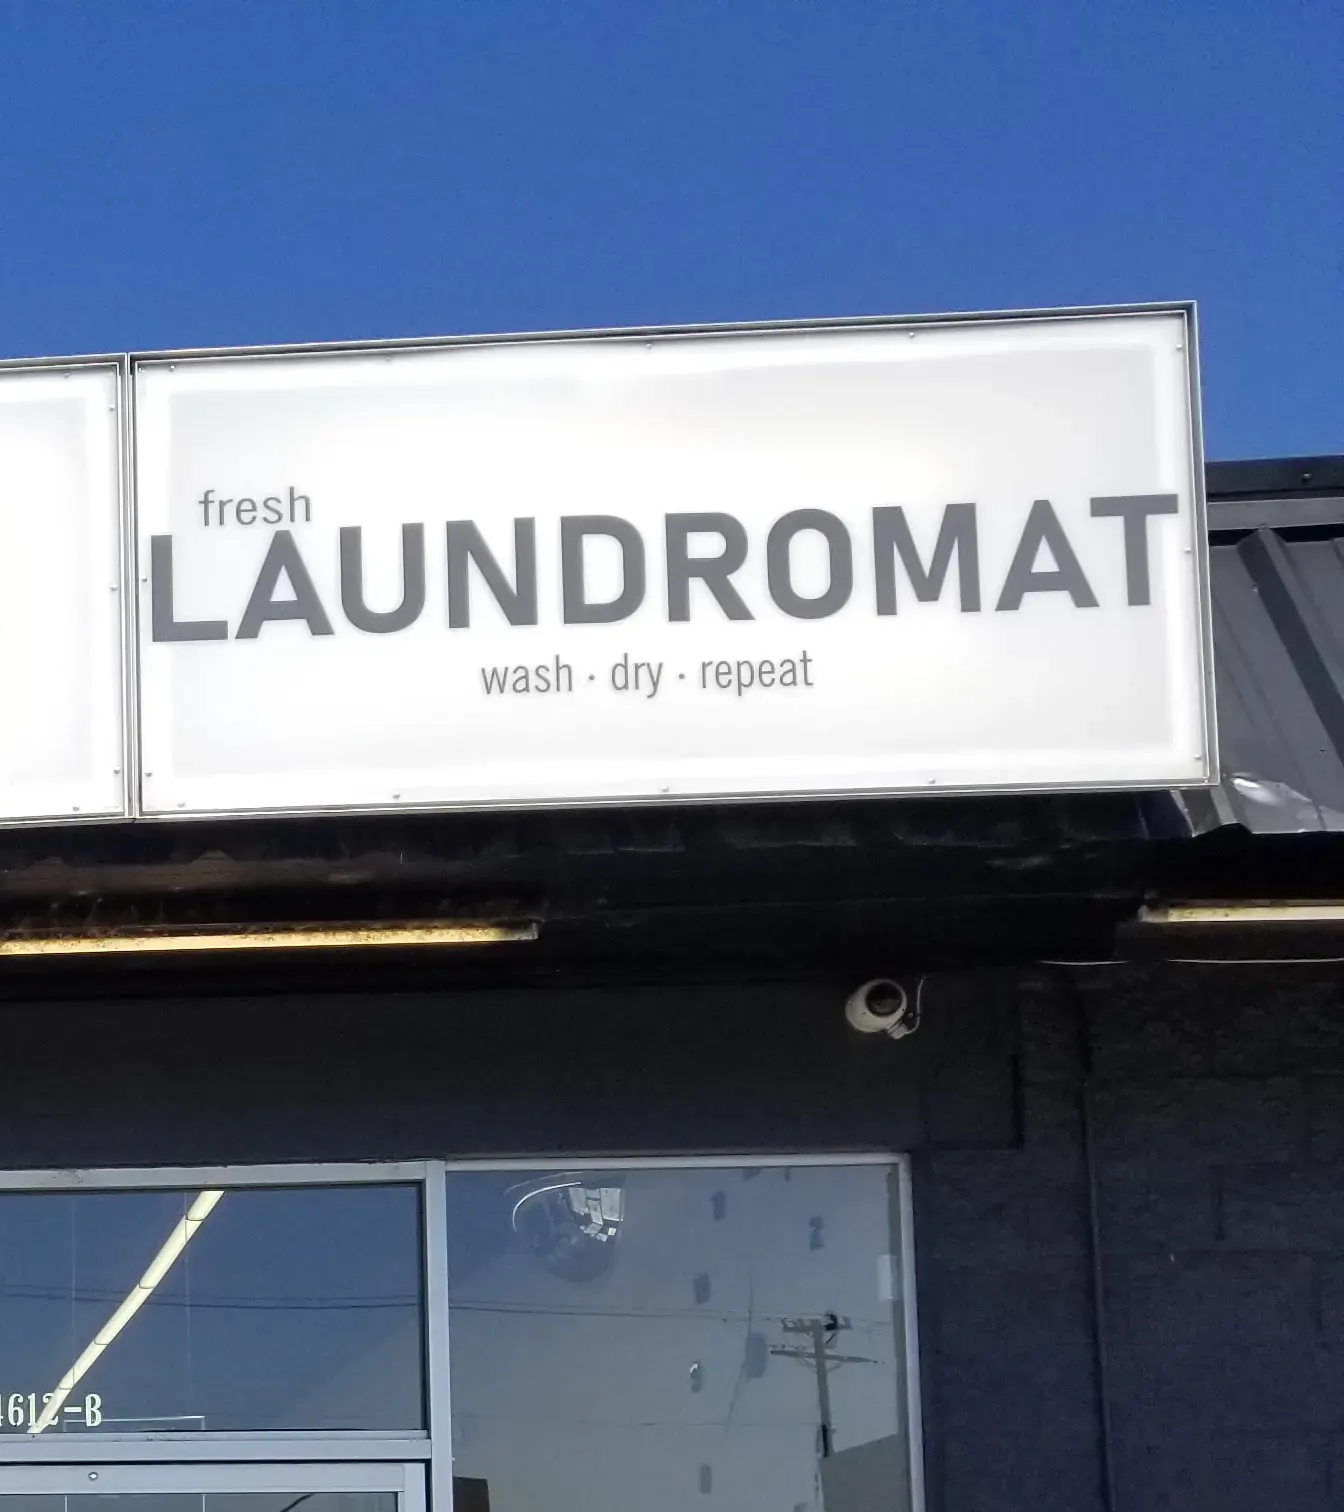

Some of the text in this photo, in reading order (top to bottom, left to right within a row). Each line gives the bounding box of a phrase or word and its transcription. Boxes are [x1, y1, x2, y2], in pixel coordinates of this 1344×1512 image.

[198, 486, 311, 527] fresh
[150, 493, 1179, 643] LAUNDROMAT
[481, 650, 814, 699] wash dry repeat
